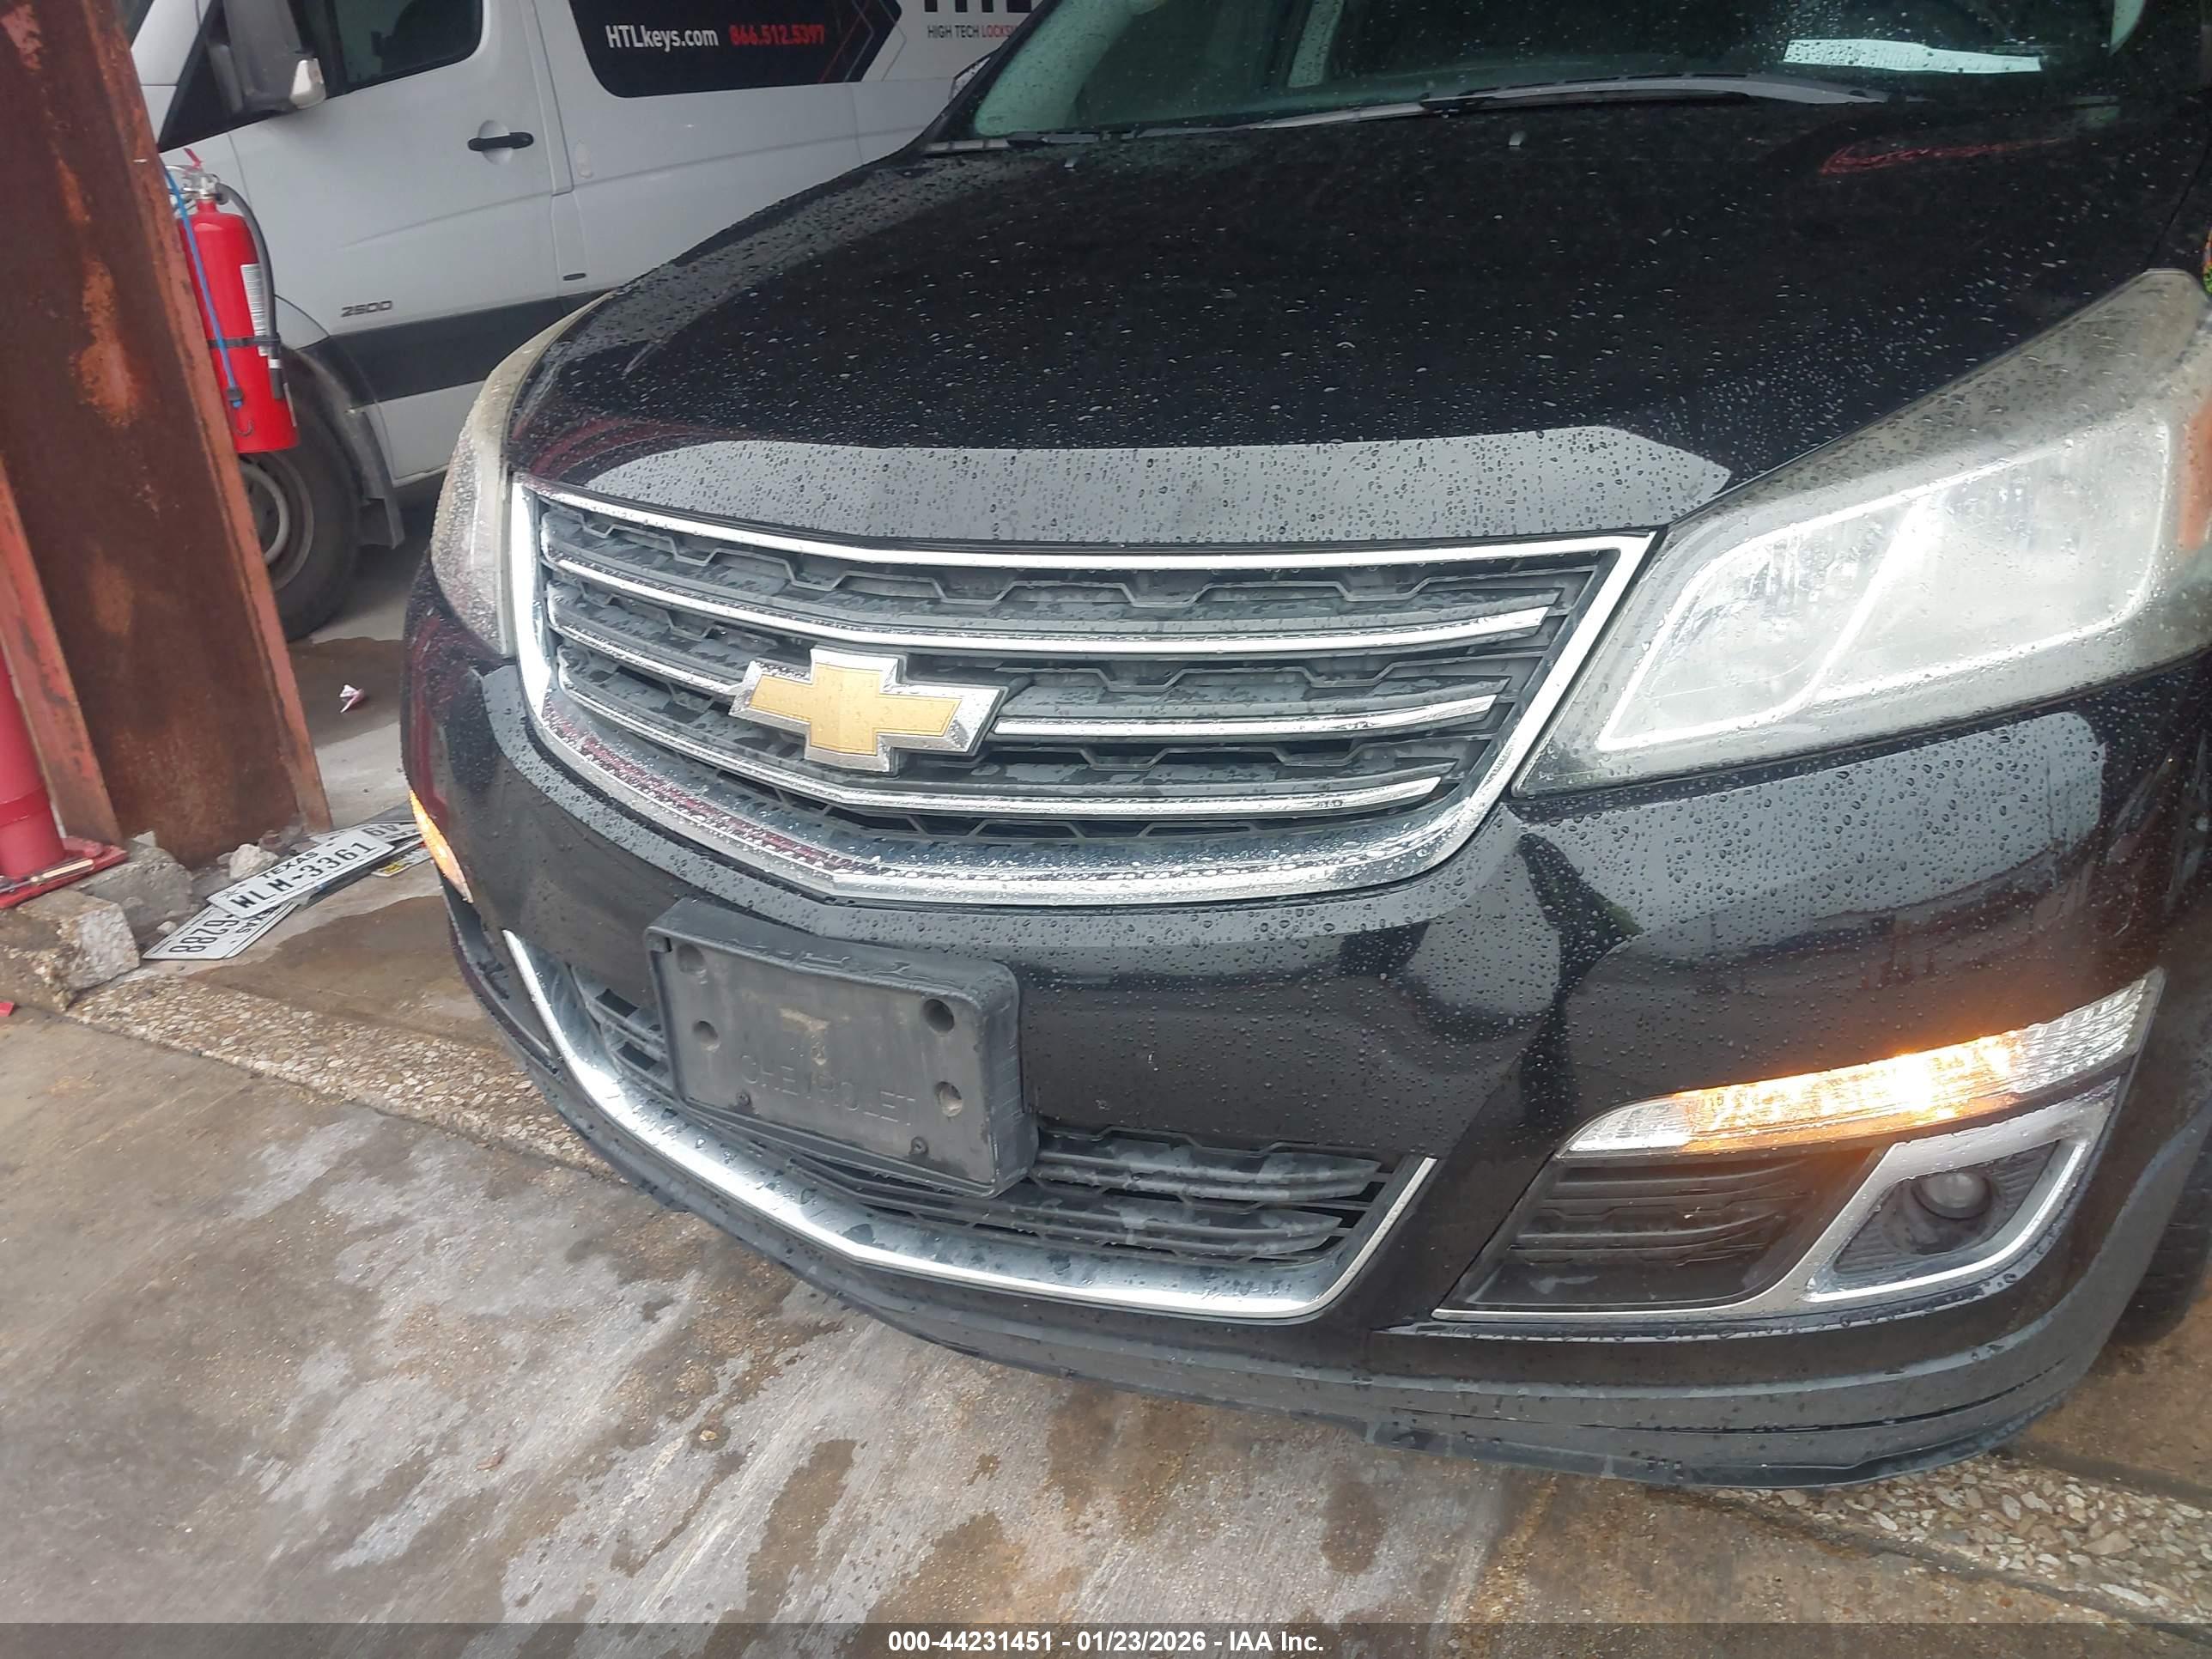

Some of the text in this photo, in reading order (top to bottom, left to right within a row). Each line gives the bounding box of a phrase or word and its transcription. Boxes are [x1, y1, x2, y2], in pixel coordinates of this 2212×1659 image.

[605, 24, 720, 52] HTLkeys.com
[927, 25, 951, 39] HIGH
[955, 25, 979, 39] TECH
[341, 300, 392, 318] 2500
[258, 851, 319, 879] TEXAS
